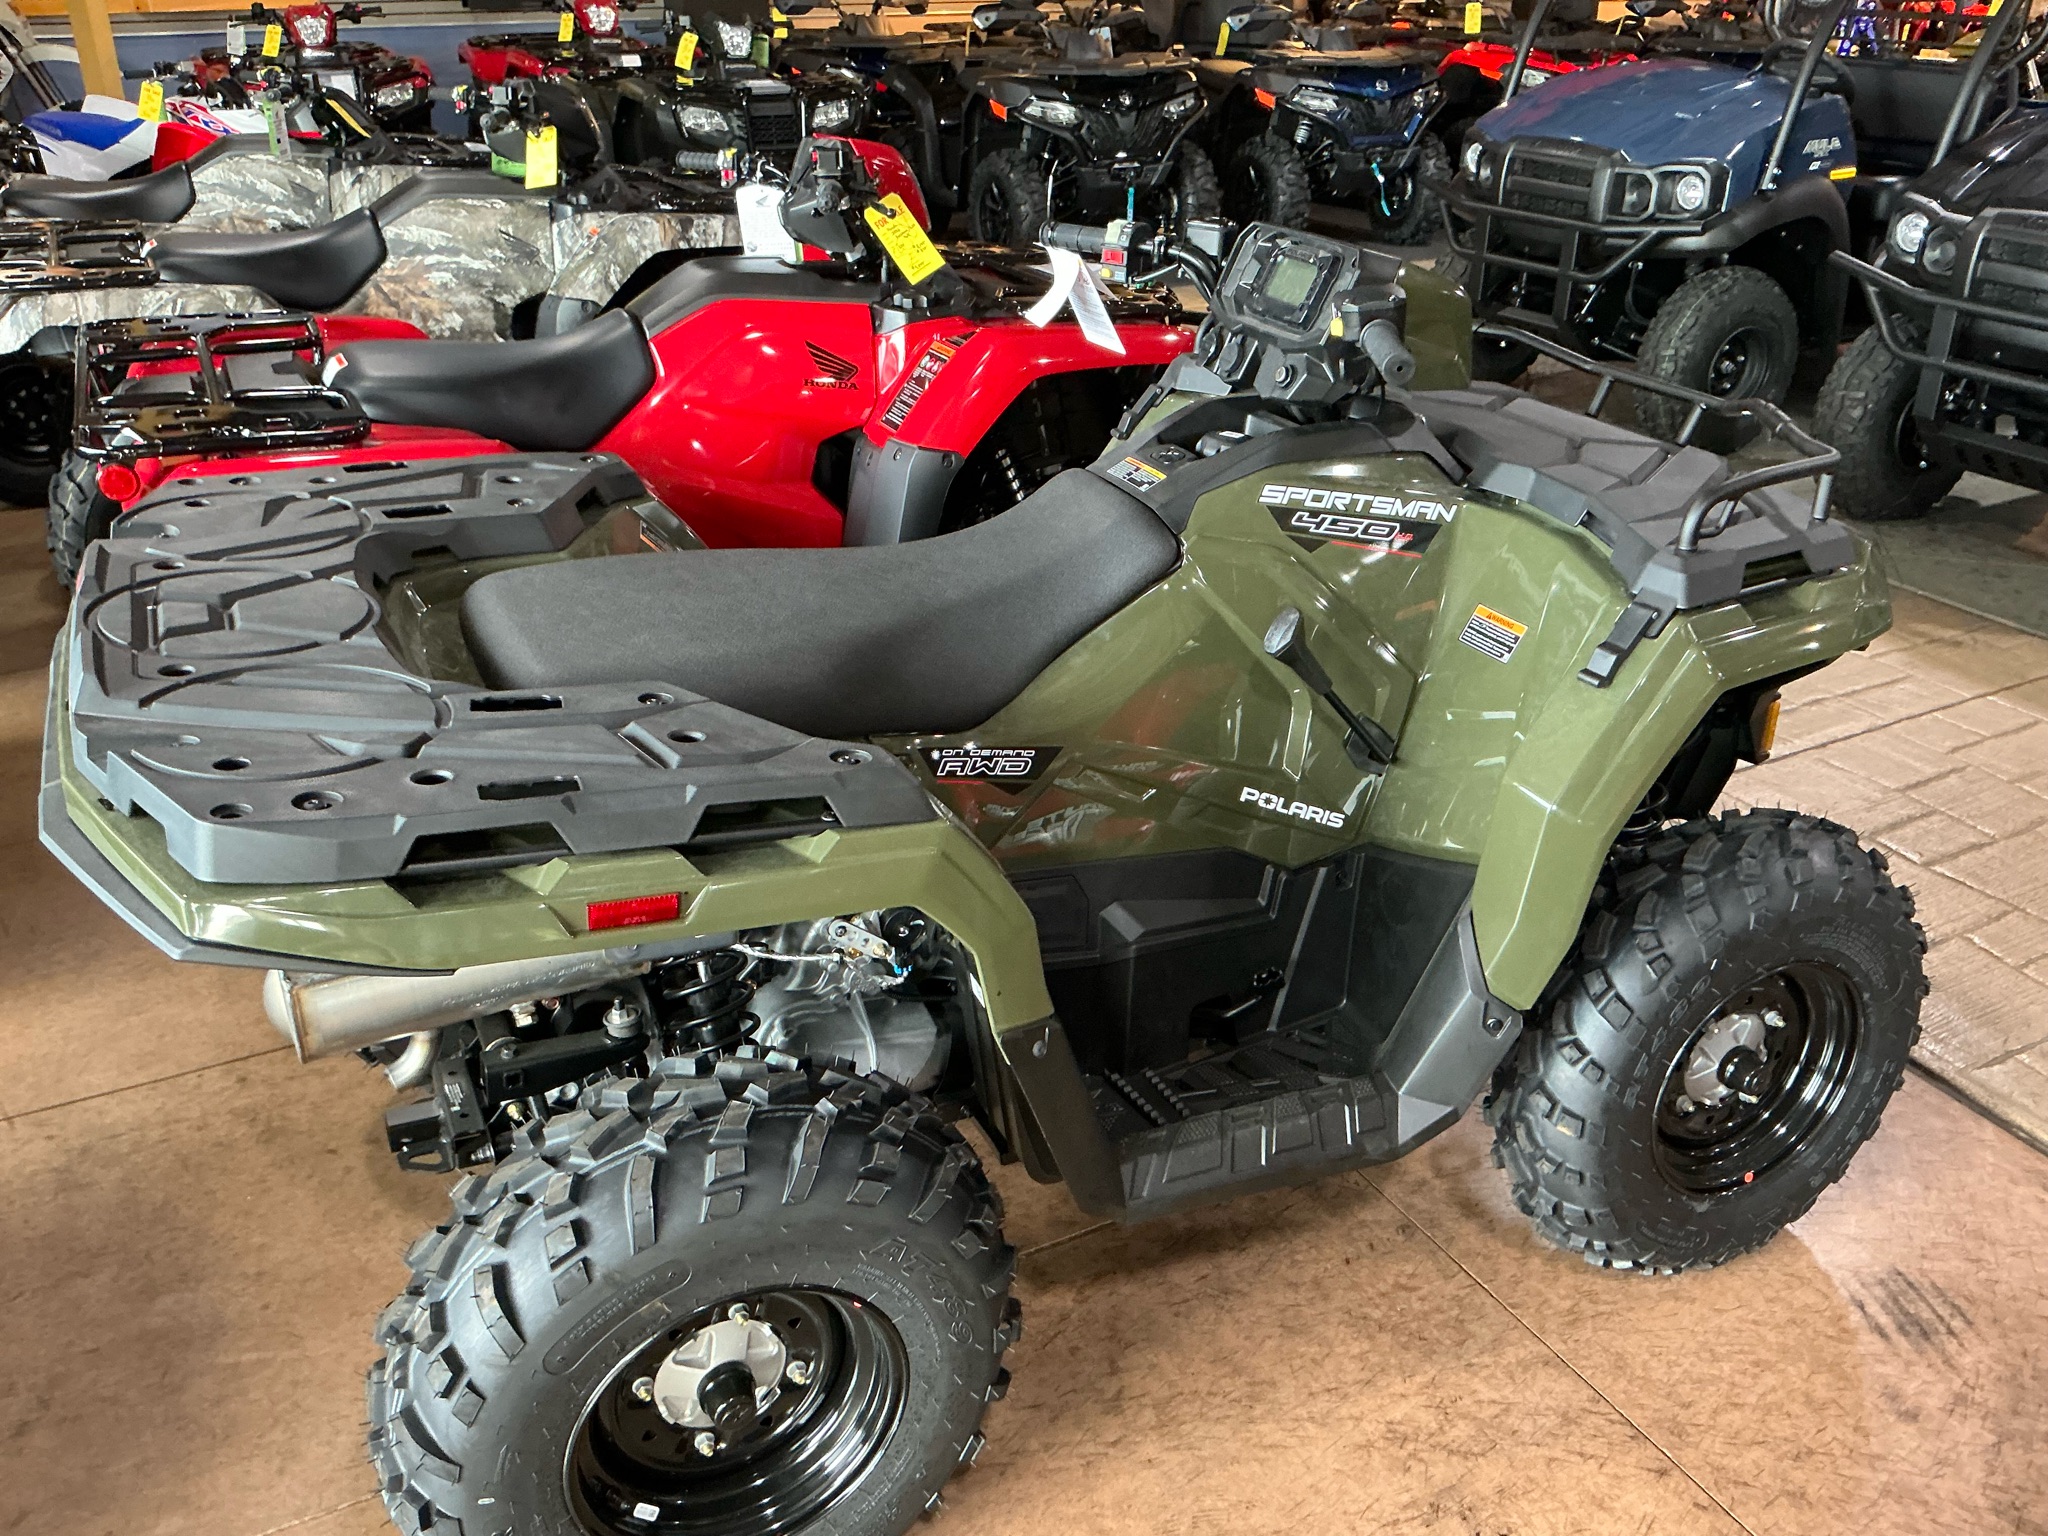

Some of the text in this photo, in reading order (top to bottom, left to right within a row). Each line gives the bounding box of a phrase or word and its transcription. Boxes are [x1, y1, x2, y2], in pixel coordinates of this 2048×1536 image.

[803, 378, 859, 390] HONDA
[1258, 484, 1458, 522] SPORTSMAN
[1291, 511, 1400, 542] 450
[1491, 613, 1515, 630] WARNING
[969, 749, 1036, 757] DEMAND
[936, 757, 1032, 776] AWD
[1239, 786, 1346, 829] POLARIS
